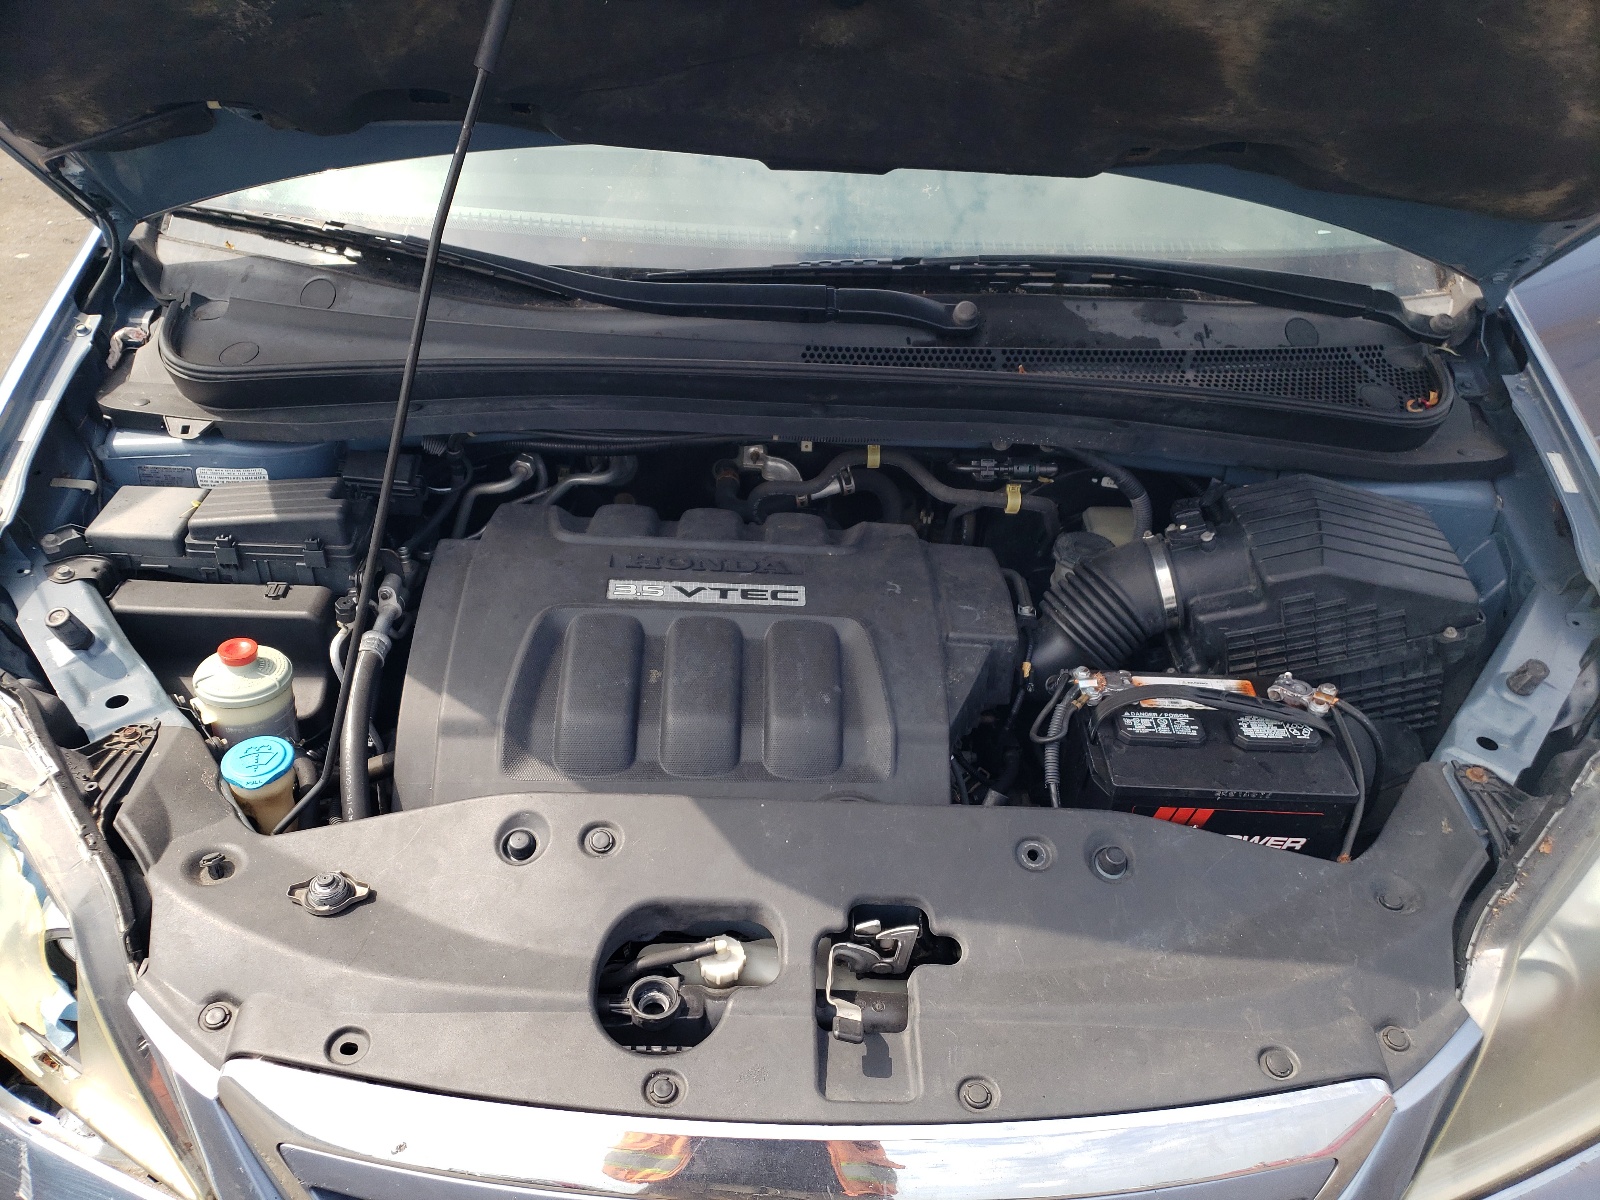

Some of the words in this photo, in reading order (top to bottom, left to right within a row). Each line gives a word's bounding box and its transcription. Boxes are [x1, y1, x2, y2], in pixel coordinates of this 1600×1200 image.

[624, 555, 796, 575] HONDA
[613, 584, 665, 597] 3.5
[672, 585, 799, 601] VTEC
[1226, 834, 1307, 850] WER
